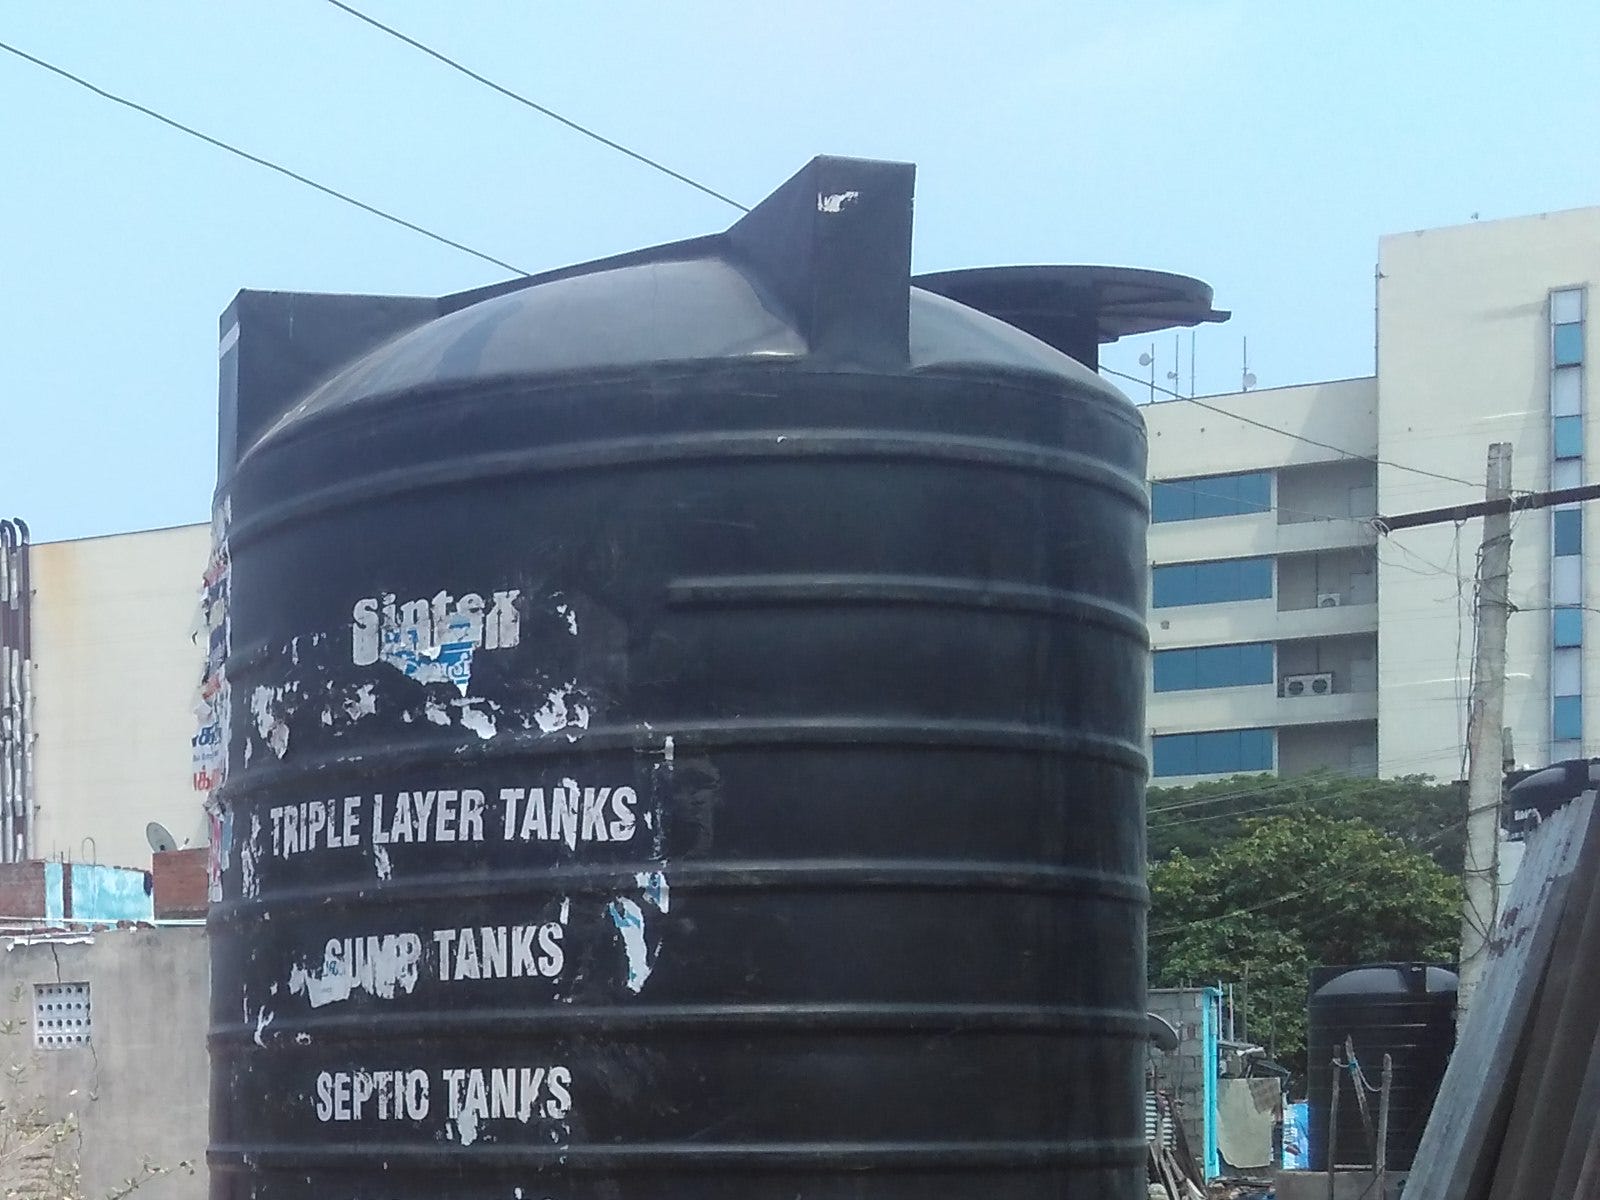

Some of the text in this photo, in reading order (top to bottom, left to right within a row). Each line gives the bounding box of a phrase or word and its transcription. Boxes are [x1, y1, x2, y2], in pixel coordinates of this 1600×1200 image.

[270, 786, 637, 859] TRIPLE LAYER TANKS
[324, 921, 565, 994] SUMP TANKS
[316, 1066, 572, 1122] SEPTIC TANKS
